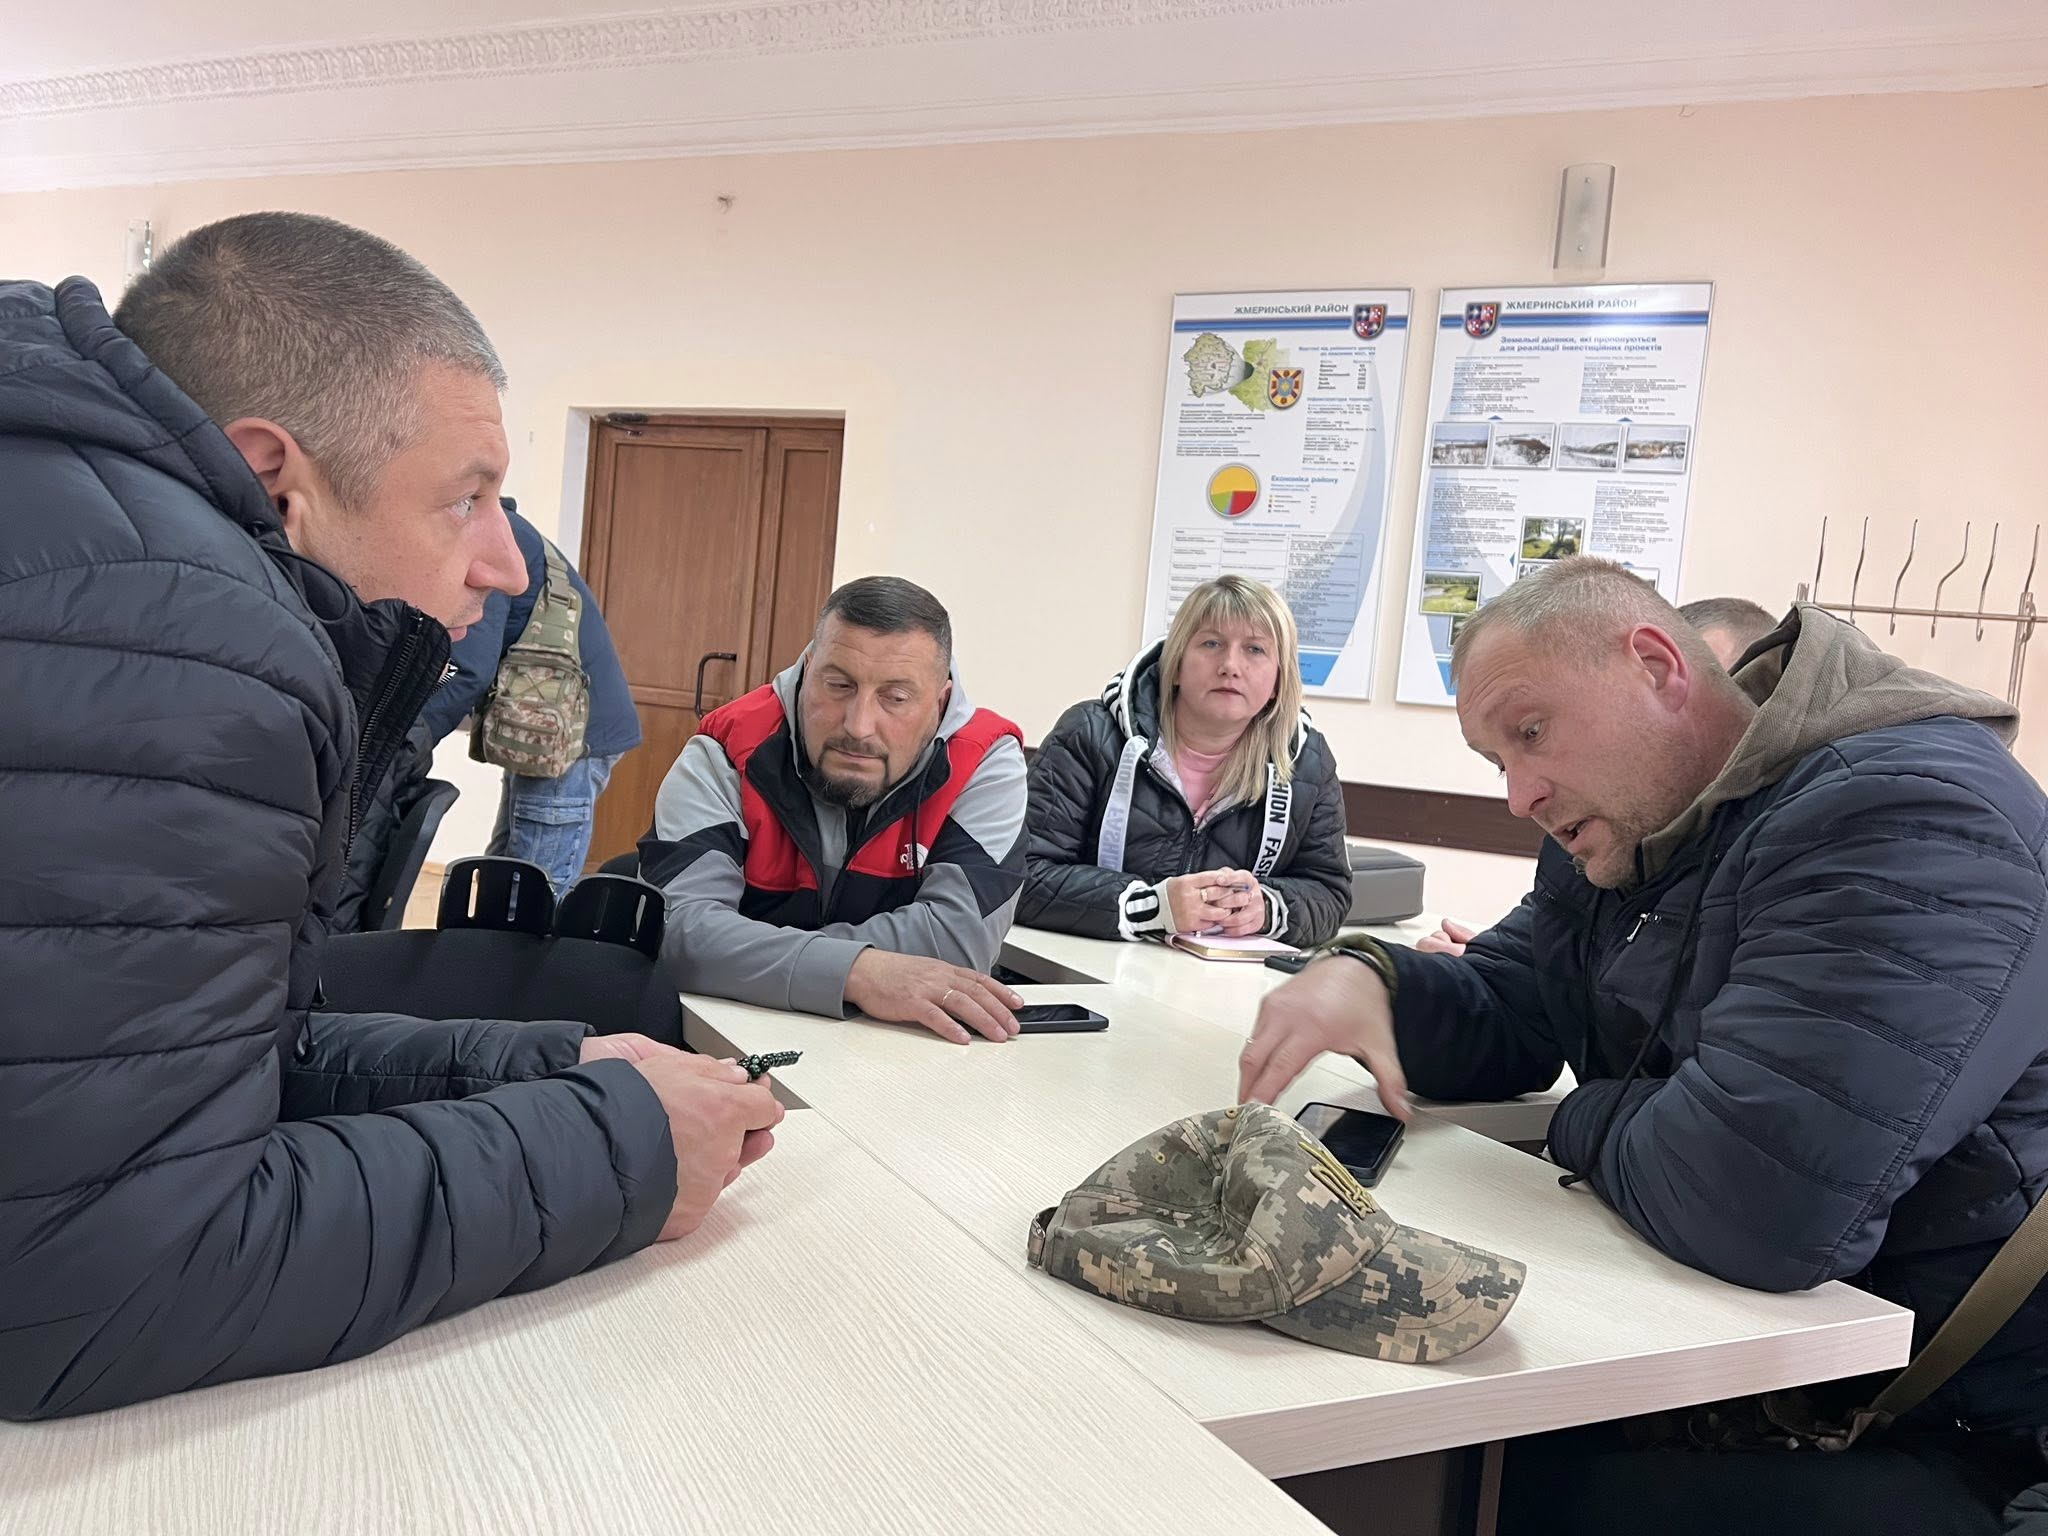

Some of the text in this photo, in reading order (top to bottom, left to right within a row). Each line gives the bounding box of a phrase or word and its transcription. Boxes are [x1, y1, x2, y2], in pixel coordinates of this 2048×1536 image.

[1234, 303, 1349, 314] ЖМЕРИНСЬКИЙ РАЙОН
[1506, 299, 1638, 310] ЖМЕРИНСЬКИЙ РАЙОН
[1541, 336, 1577, 344] ділянки,
[1594, 336, 1657, 344] пропонуються
[1517, 344, 1560, 352] реалізації
[1562, 344, 1622, 352] інвестиційних
[1624, 344, 1663, 352] проектів
[1311, 477, 1339, 485] району
